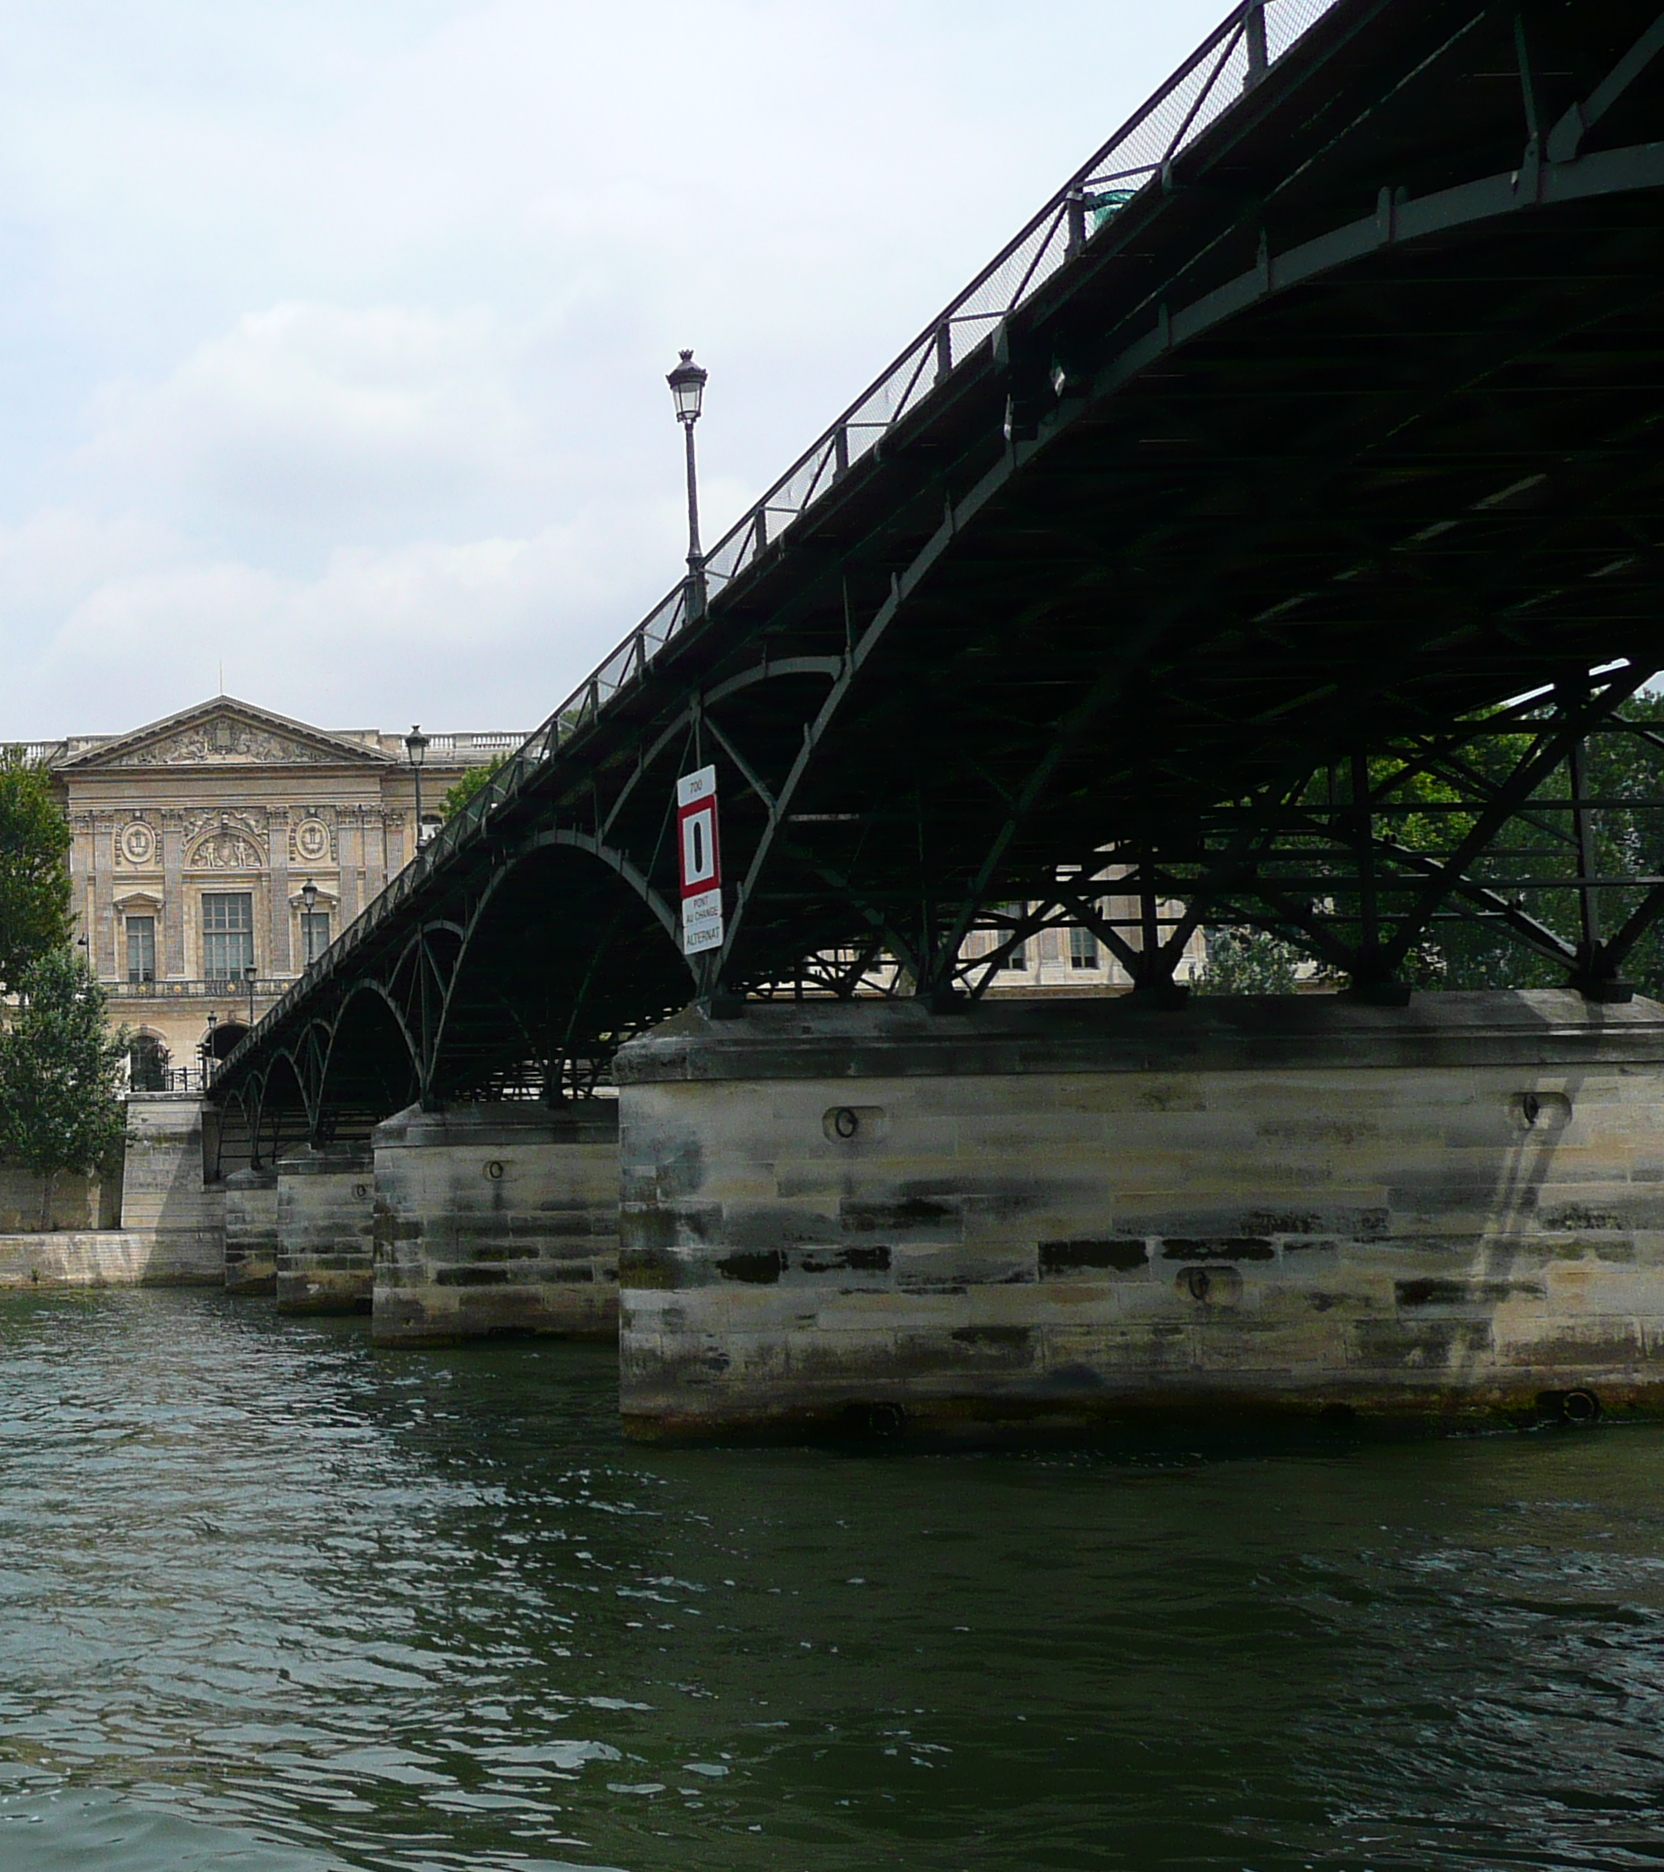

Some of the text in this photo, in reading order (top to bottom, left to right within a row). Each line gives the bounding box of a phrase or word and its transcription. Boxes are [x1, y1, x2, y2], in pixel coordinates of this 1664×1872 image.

[689, 779, 703, 795] 700
[693, 896, 709, 909] PONT
[686, 912, 694, 924] AU
[686, 925, 720, 947] ALTERNAT
